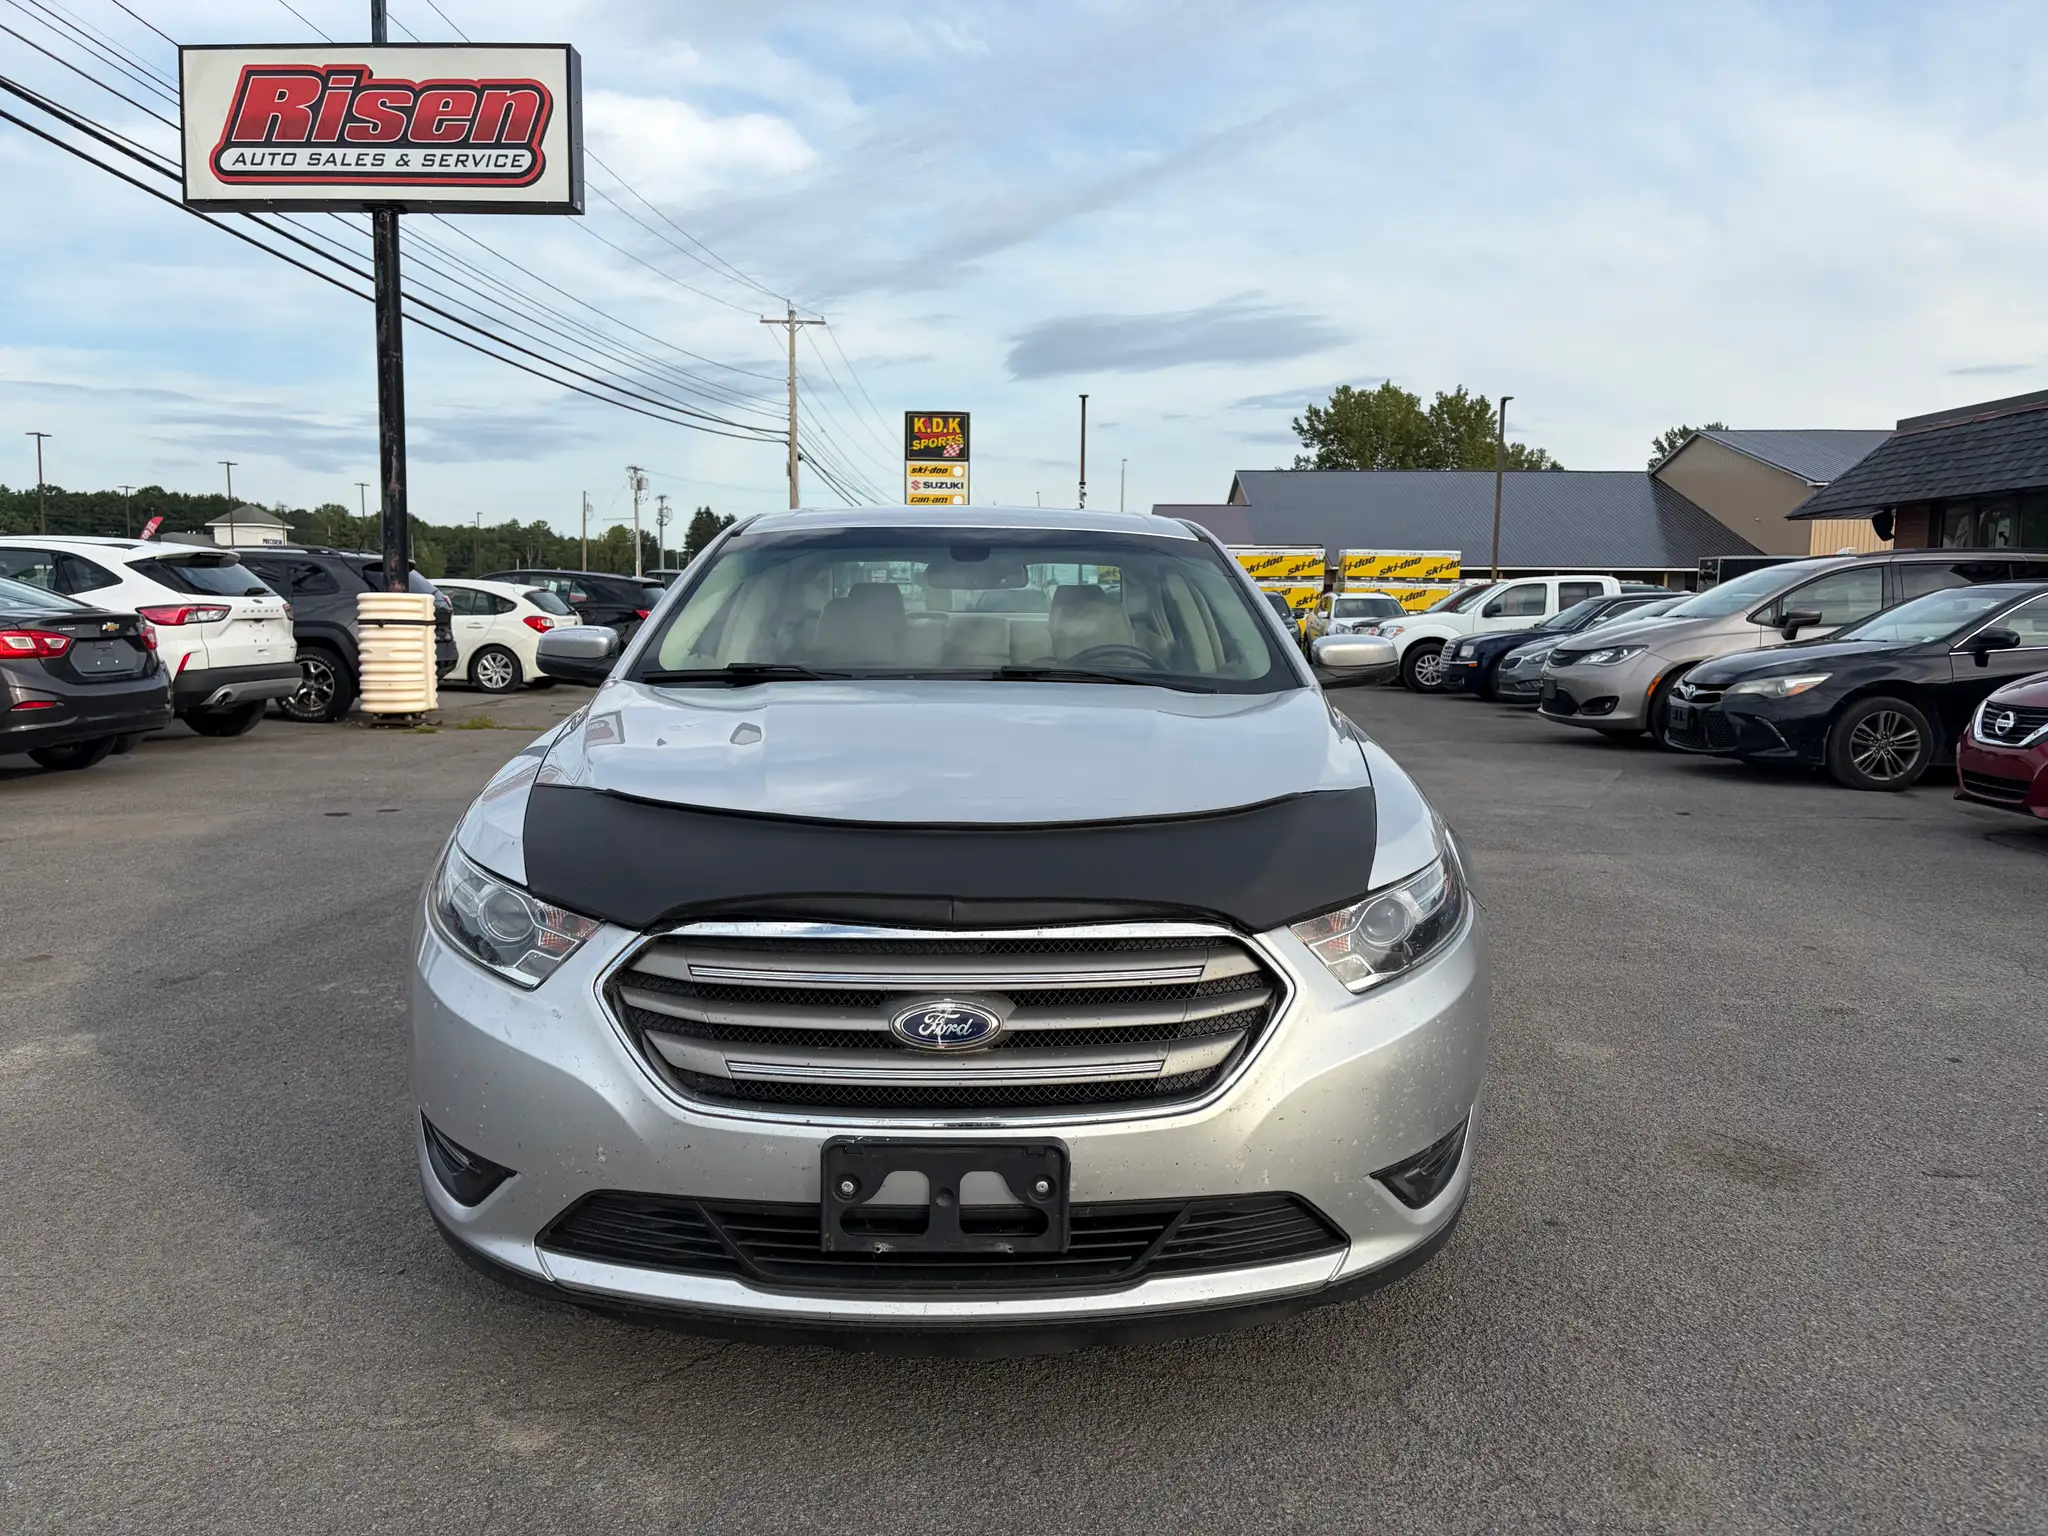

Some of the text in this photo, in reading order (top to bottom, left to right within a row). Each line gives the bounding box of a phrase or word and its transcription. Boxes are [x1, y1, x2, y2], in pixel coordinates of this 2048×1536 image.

[231, 75, 542, 143] Risen
[232, 152, 526, 168] AUTO SALES & SERVICE
[913, 417, 961, 433] K.D.K
[912, 434, 964, 451] SPORTS
[910, 466, 949, 474] ski-doo
[923, 481, 964, 490] SUZUKI
[910, 496, 949, 504] can-am
[1379, 557, 1422, 576] ski-doo
[1424, 560, 1461, 577] ski-do
[918, 1012, 974, 1036] Ford
